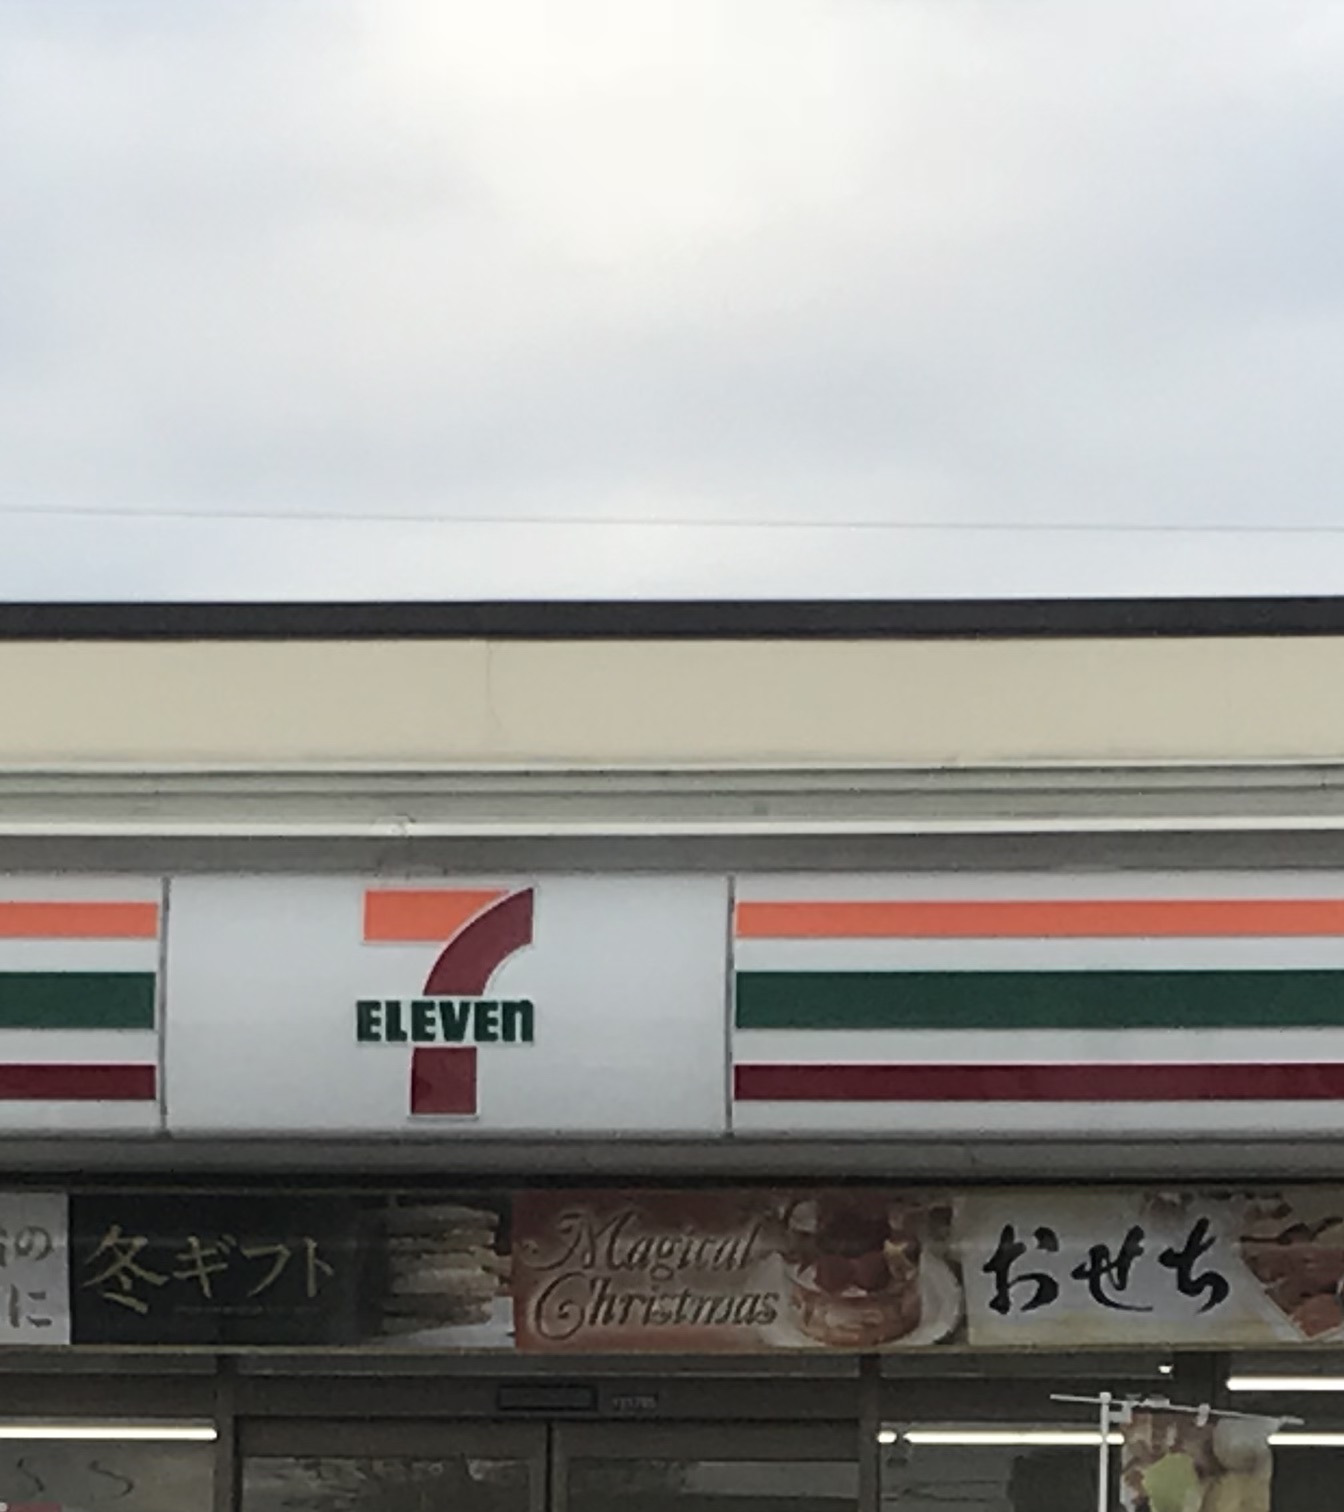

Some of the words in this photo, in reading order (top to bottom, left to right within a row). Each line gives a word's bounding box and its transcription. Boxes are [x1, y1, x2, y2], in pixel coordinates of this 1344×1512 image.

[82, 1224, 335, 1315] 冬ギフト
[521, 1206, 761, 1280] Magical
[980, 1217, 1231, 1315] おせち
[534, 1273, 781, 1342] Christmas
